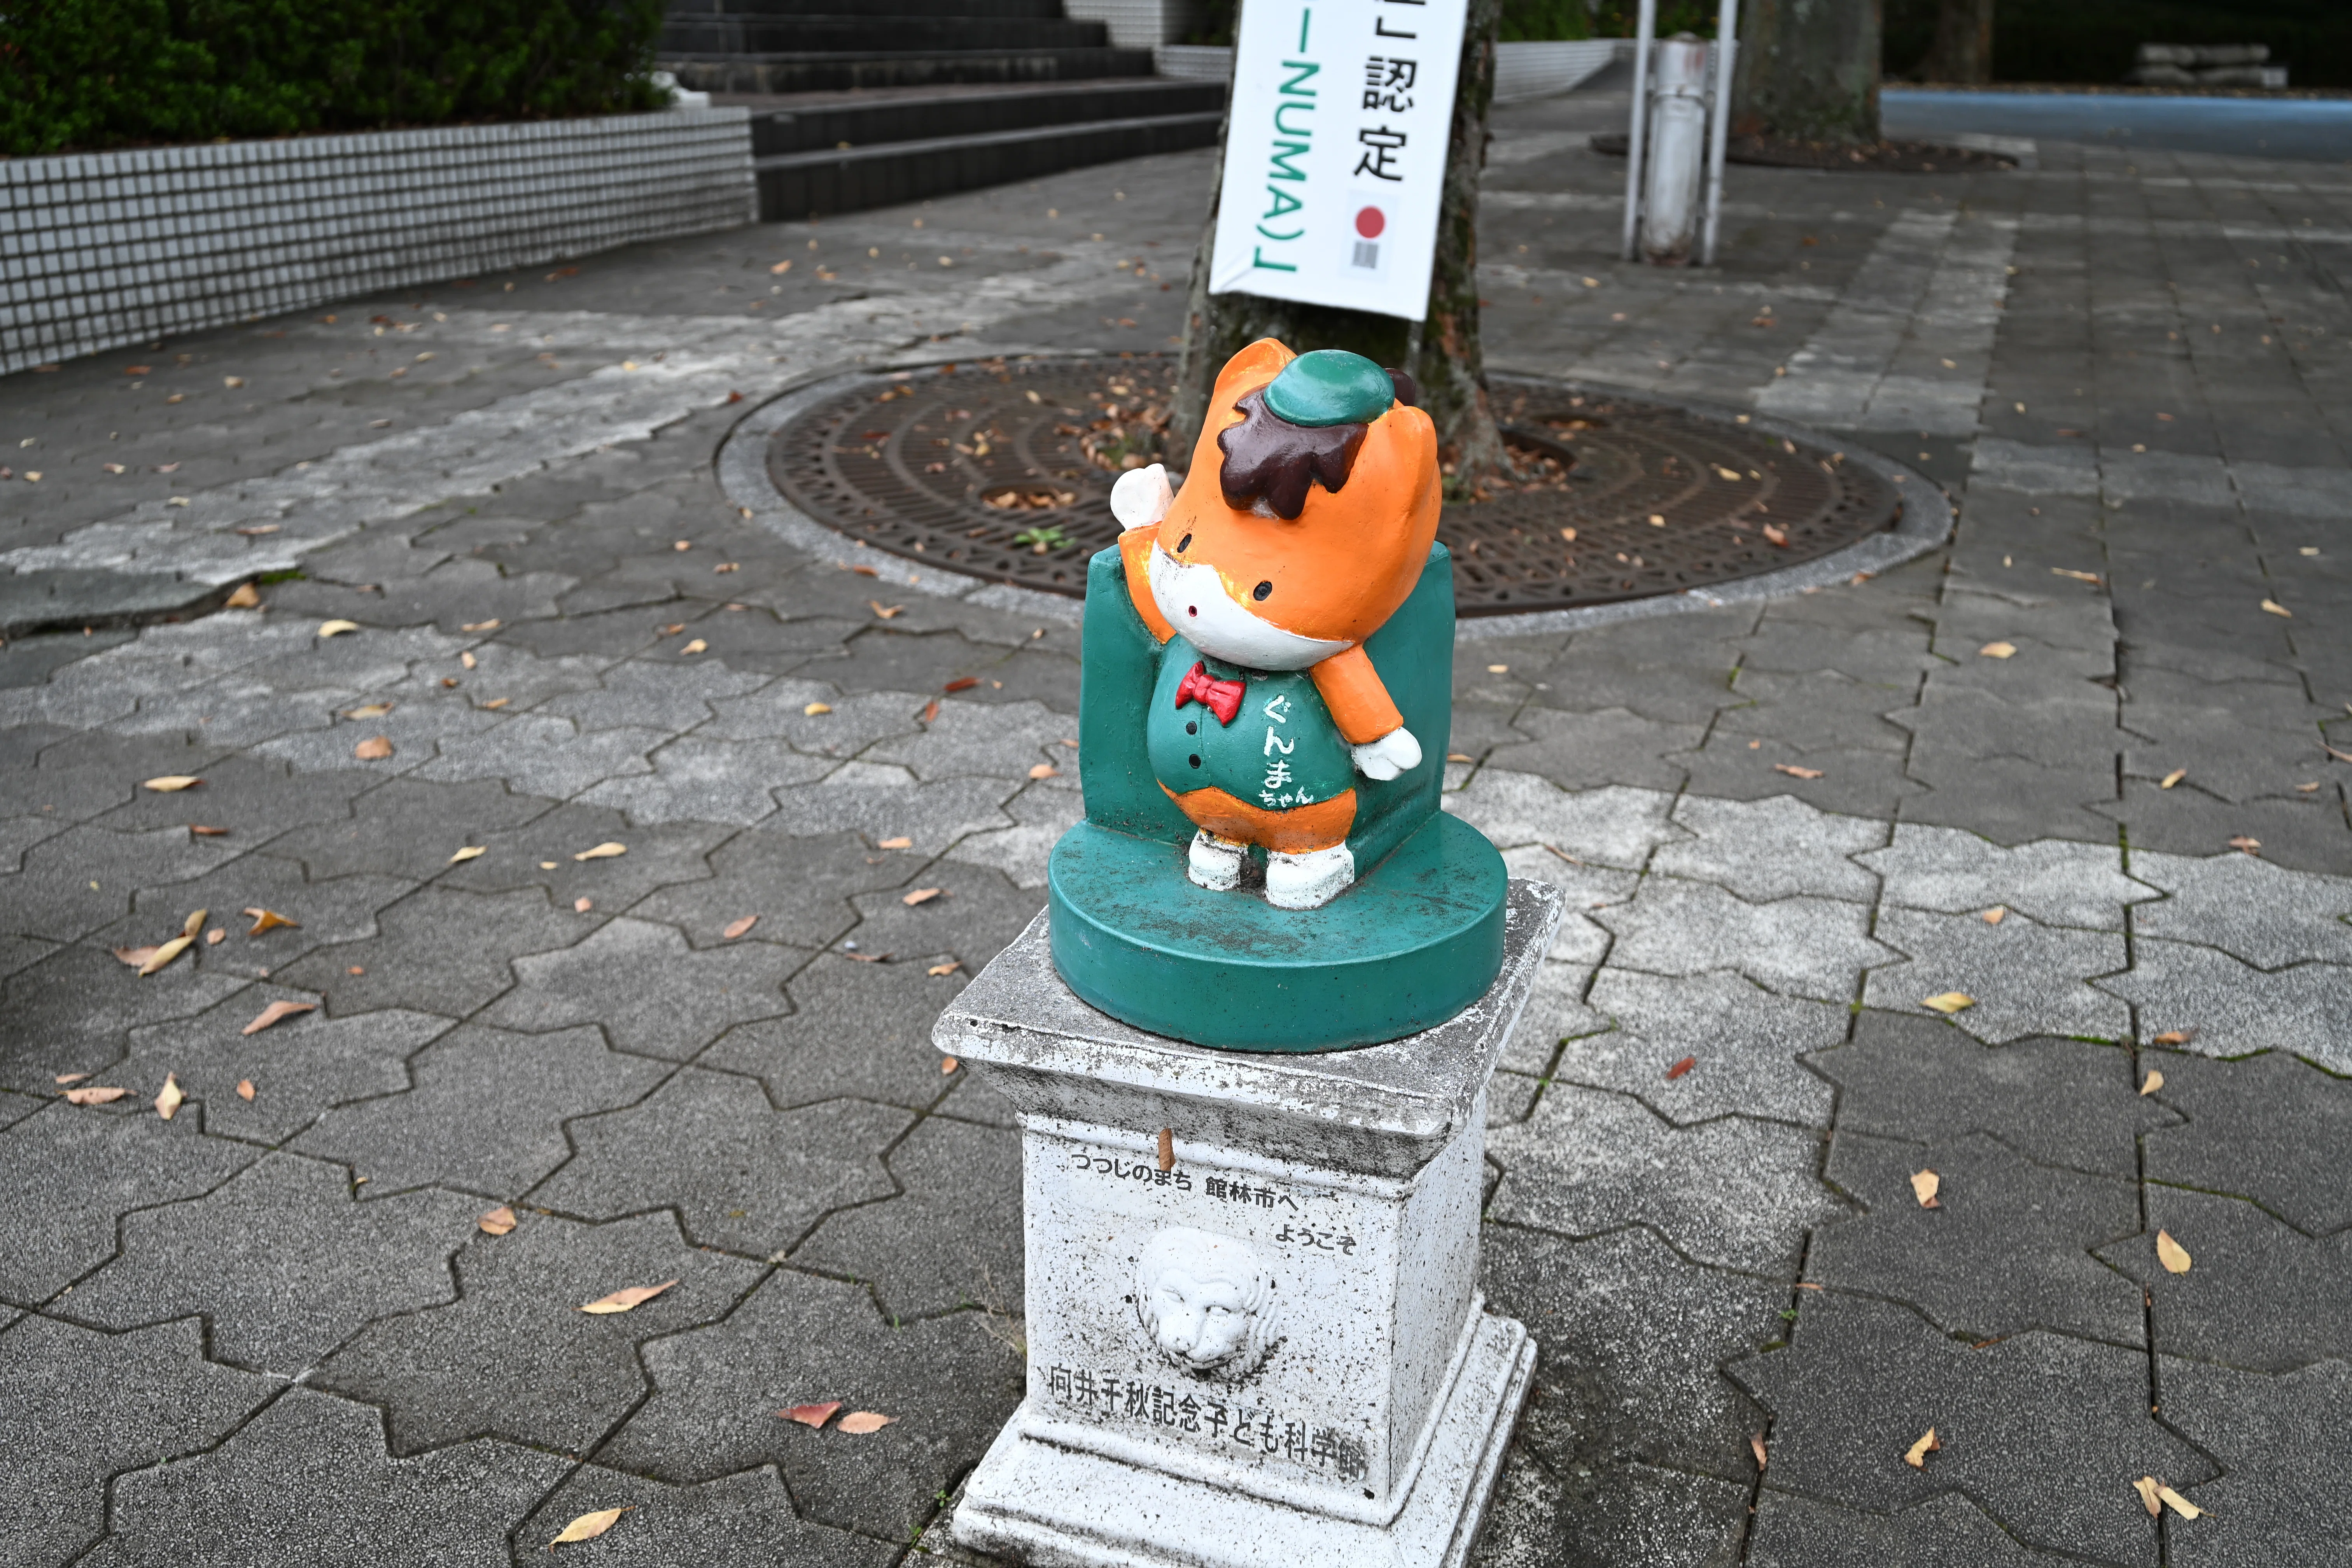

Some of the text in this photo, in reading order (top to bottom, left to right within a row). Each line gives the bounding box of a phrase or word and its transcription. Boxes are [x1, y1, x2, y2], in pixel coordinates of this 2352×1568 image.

[1354, 0, 1428, 181] 」認定
[1263, 695, 1295, 789] ぐんま
[1258, 785, 1314, 808] ちゃん
[1071, 1154, 1299, 1211] つつじのまち 館林市へ
[1275, 1223, 1356, 1256] ようこそ
[1050, 1362, 1366, 1481] 向井千秋記念子ども科学館
